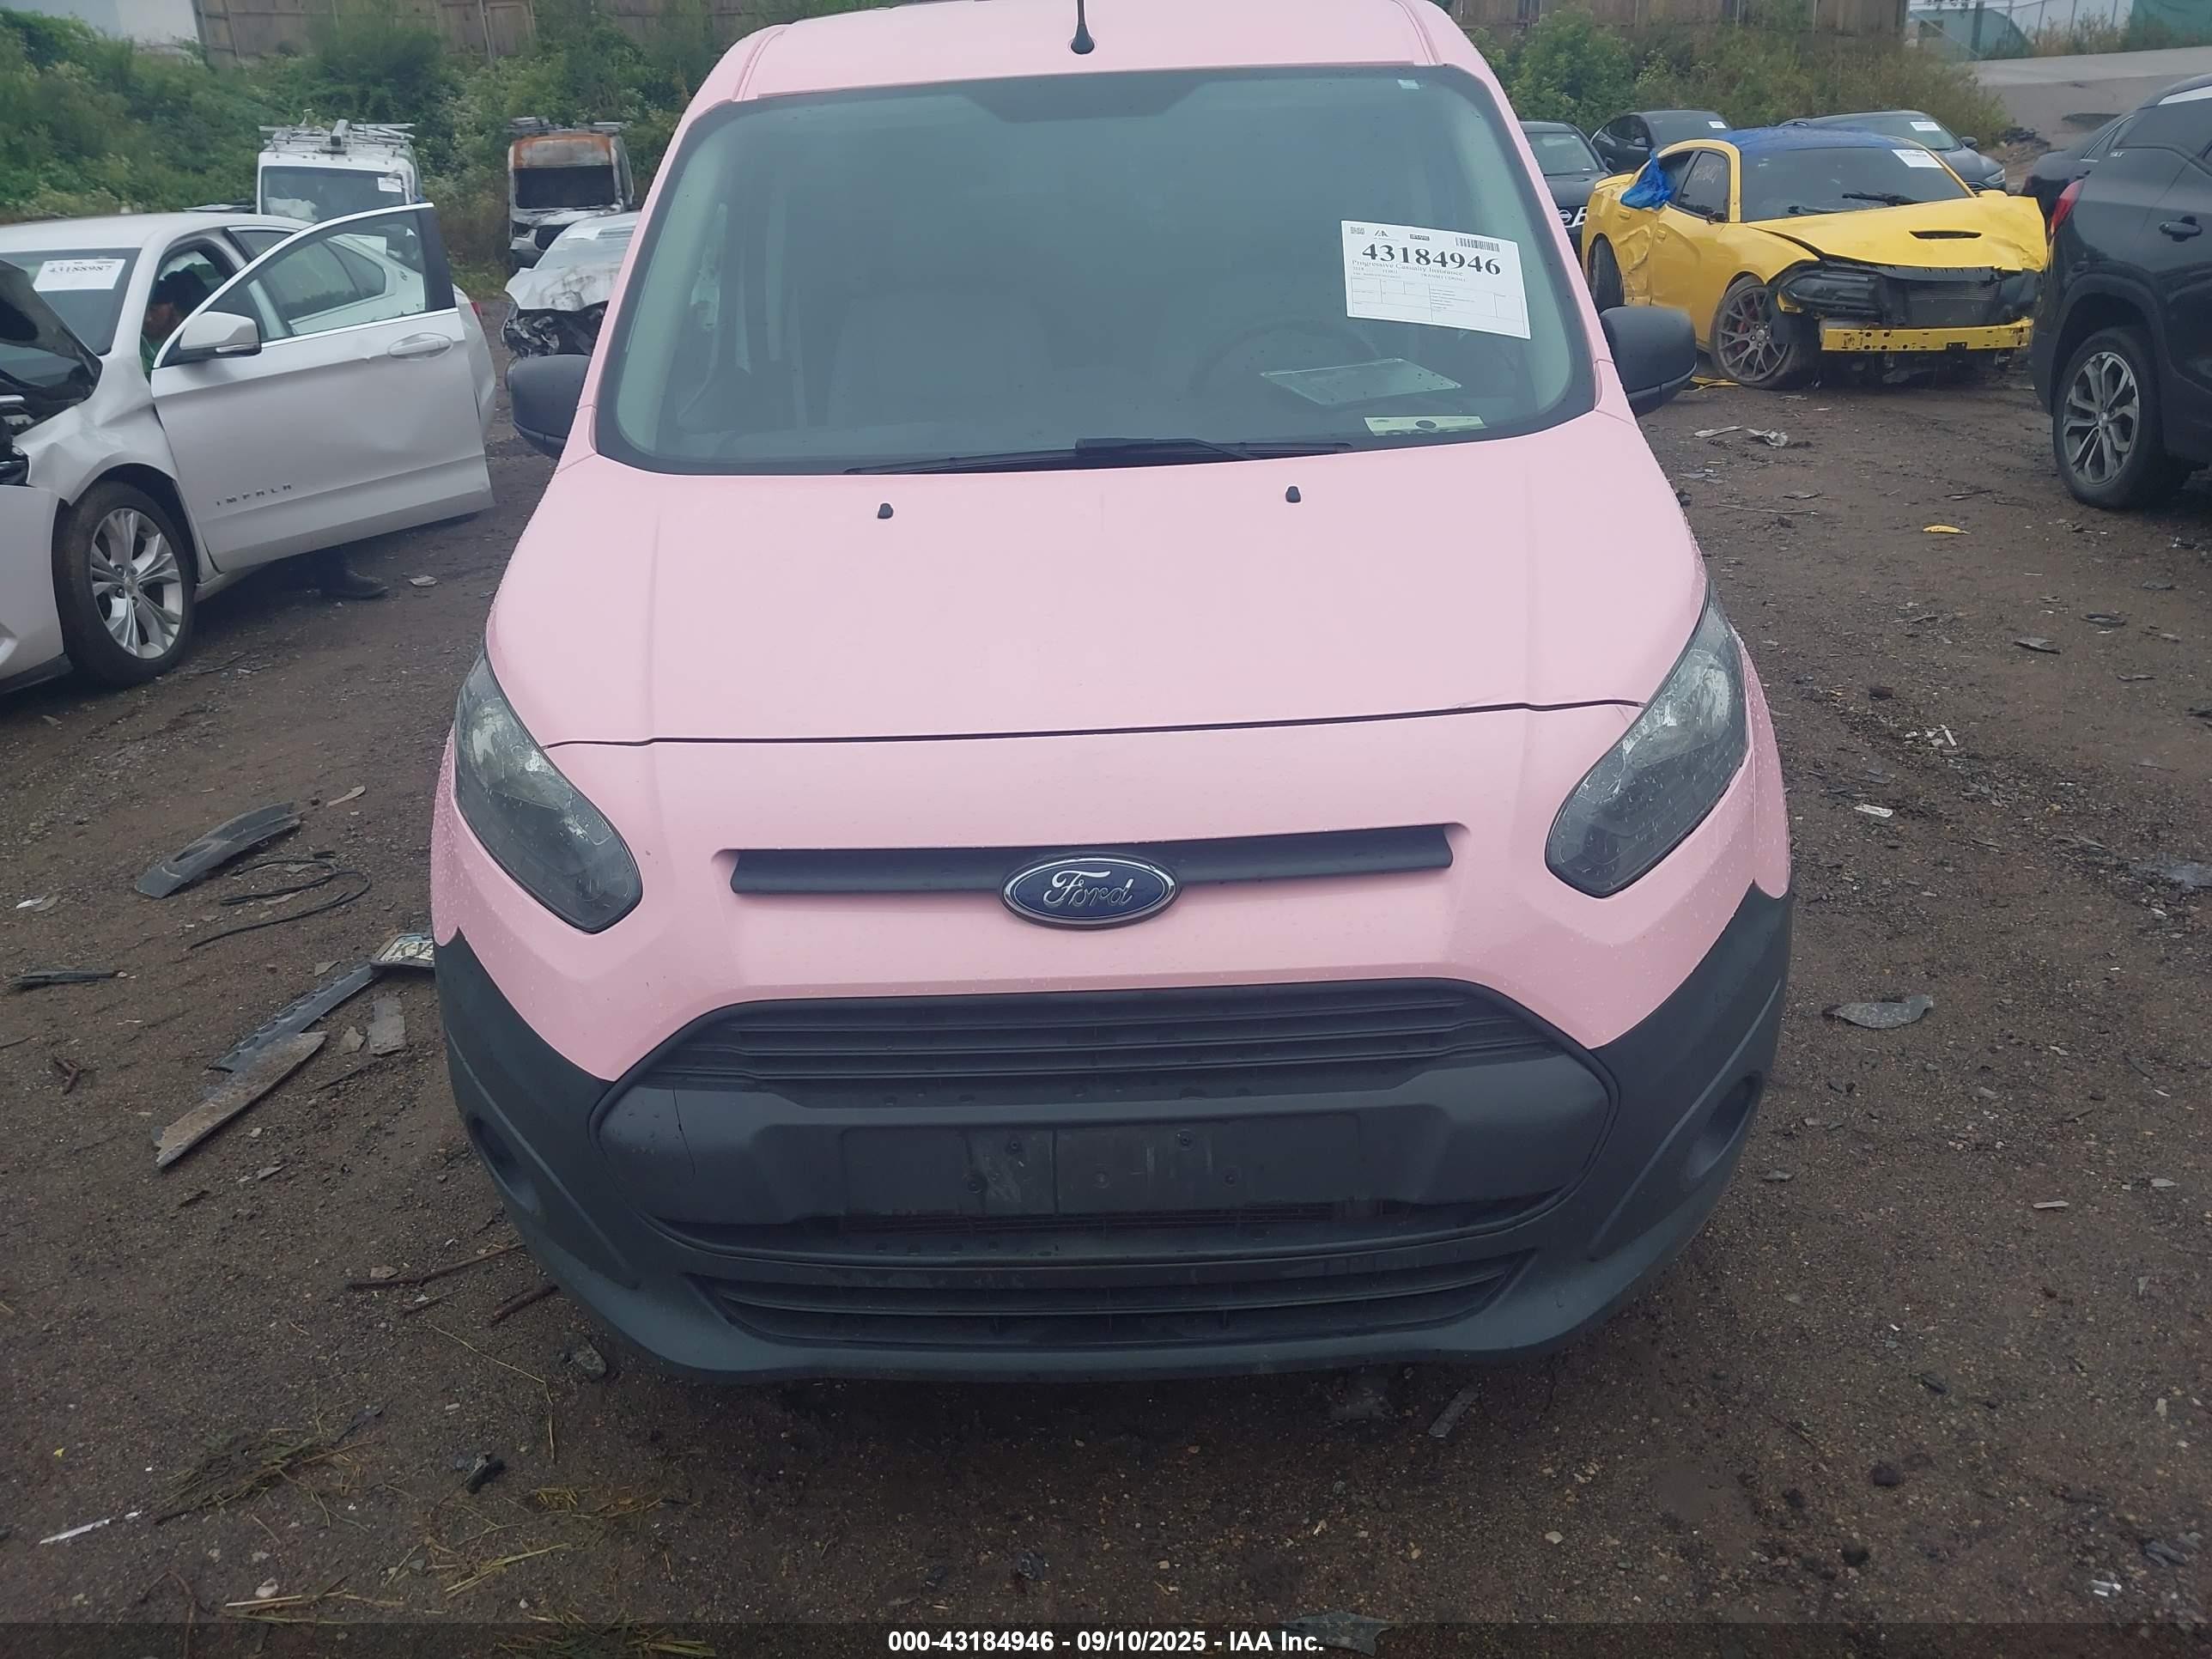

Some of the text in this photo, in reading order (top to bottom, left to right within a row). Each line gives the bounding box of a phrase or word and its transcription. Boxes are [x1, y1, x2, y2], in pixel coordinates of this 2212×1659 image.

[1362, 243, 1501, 276] 43184946
[216, 483, 292, 506] IMPALA
[1043, 870, 1134, 908] Ford
